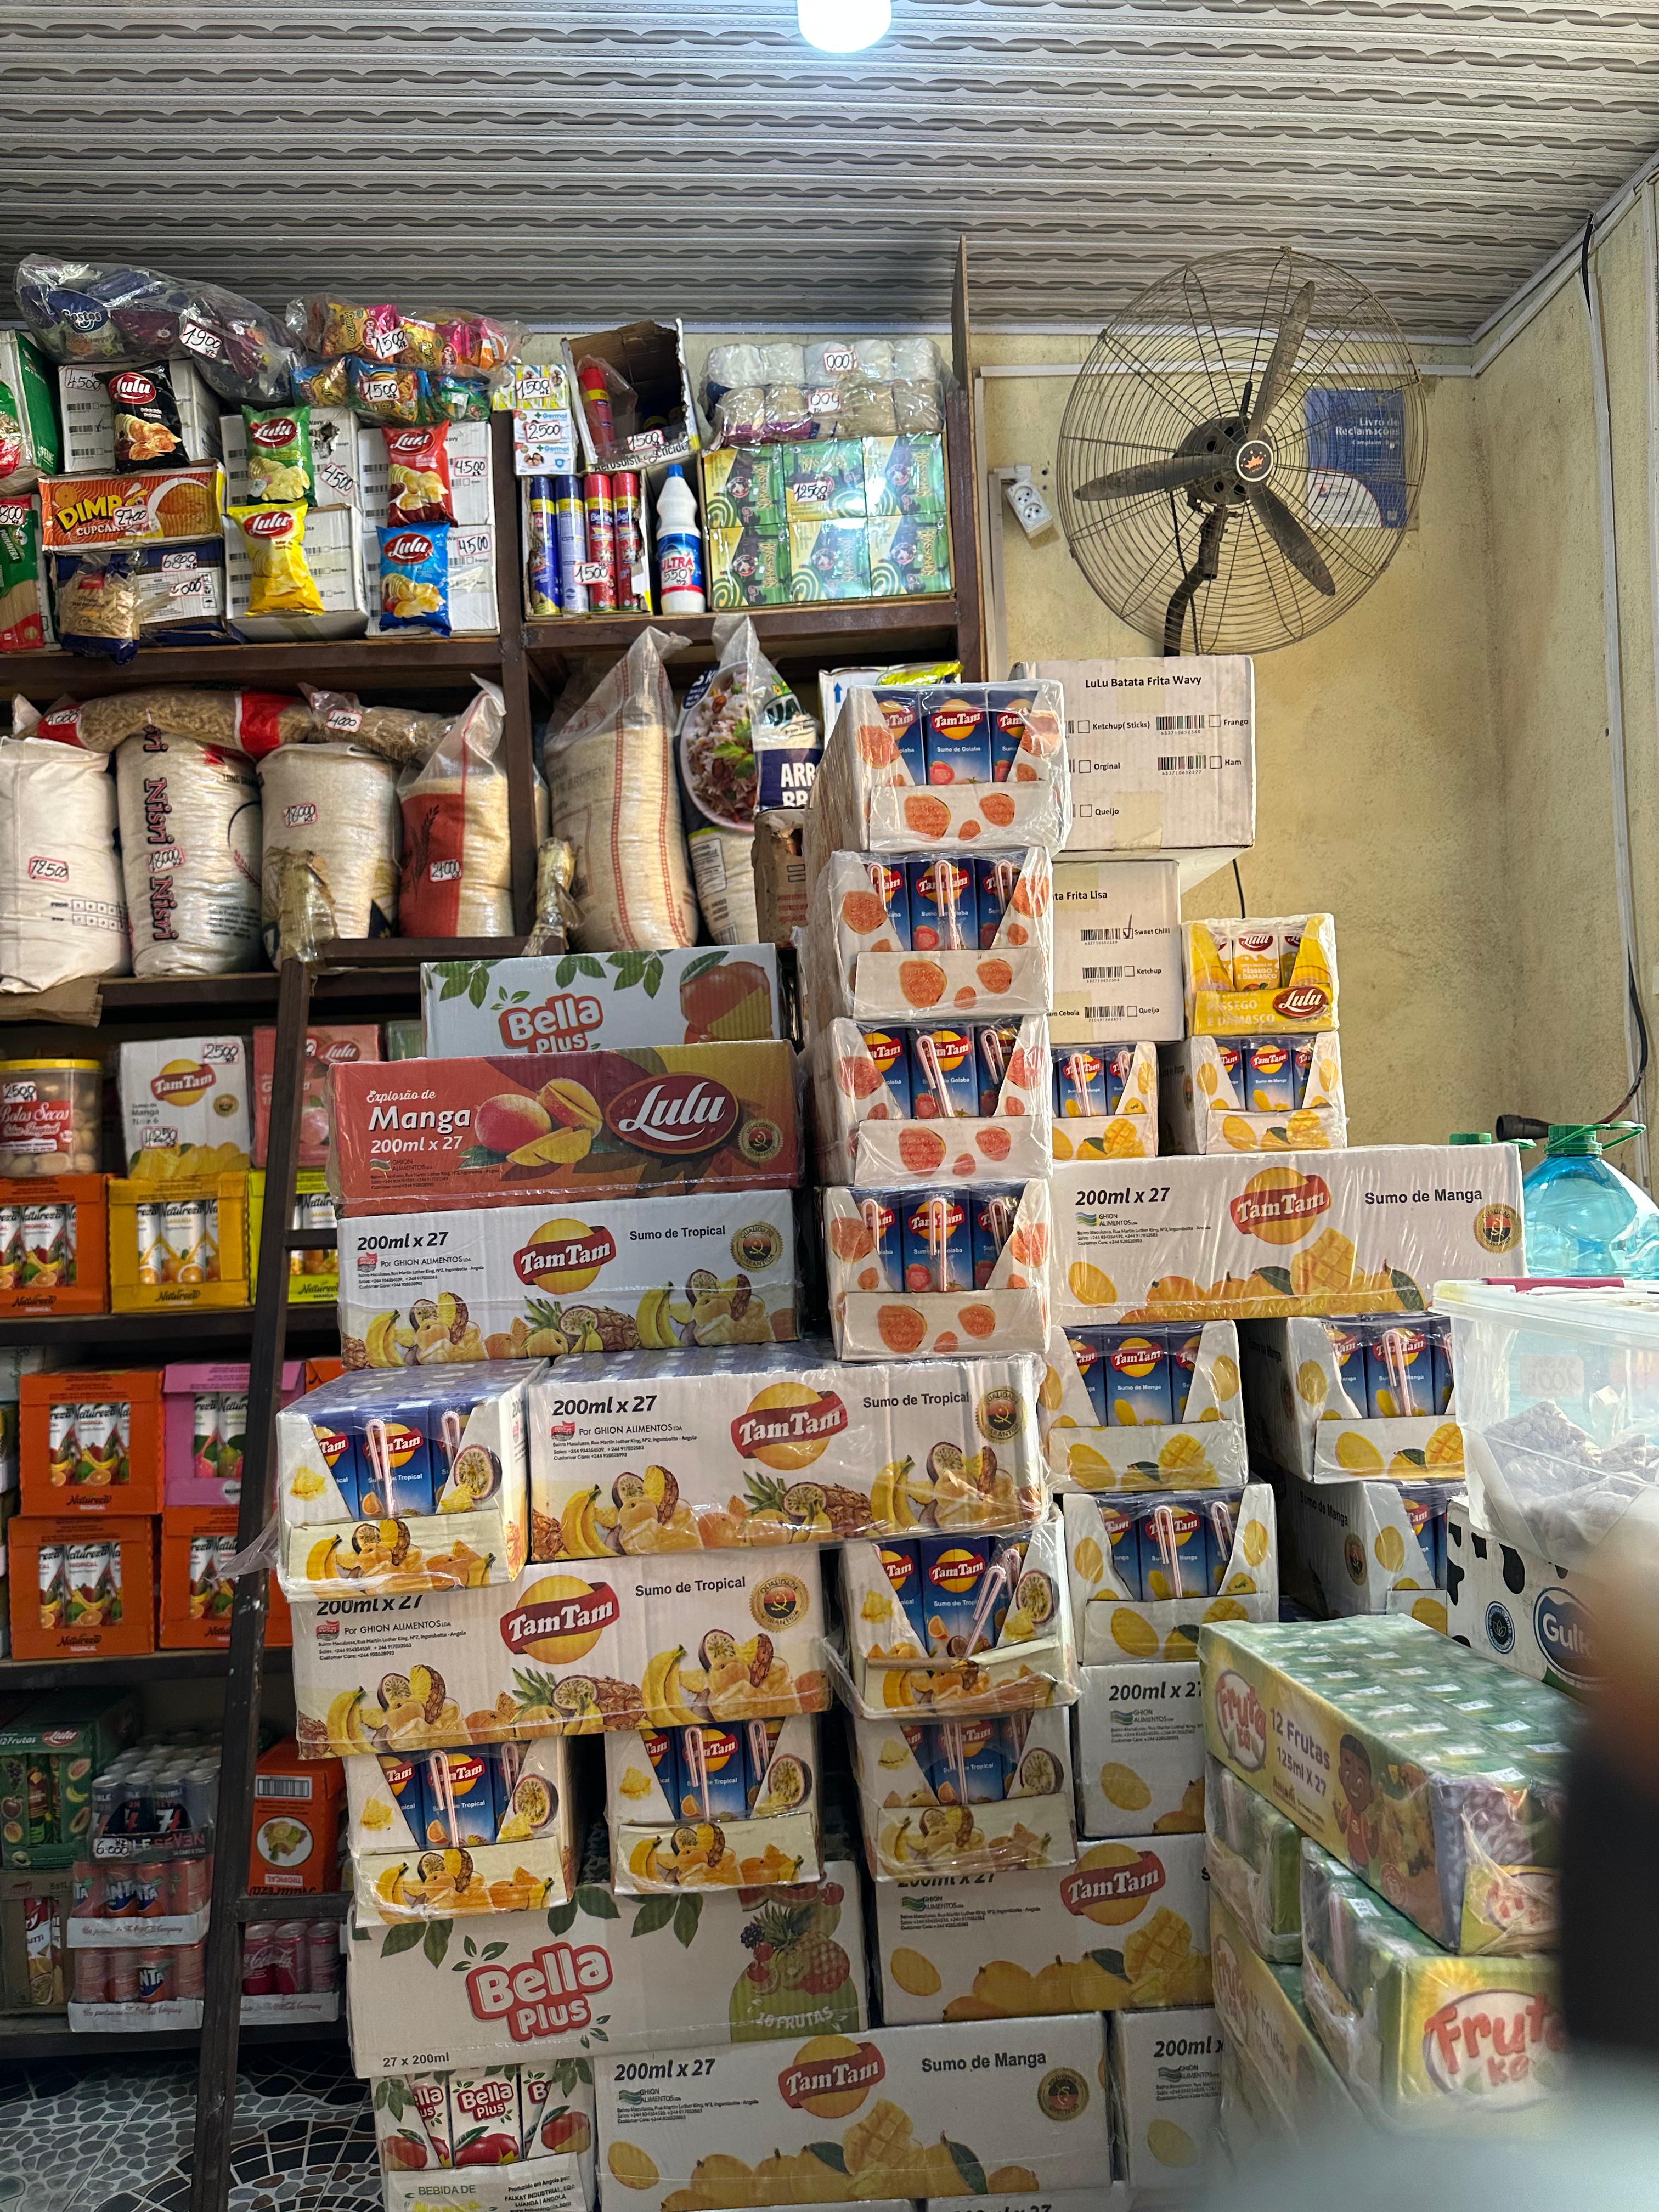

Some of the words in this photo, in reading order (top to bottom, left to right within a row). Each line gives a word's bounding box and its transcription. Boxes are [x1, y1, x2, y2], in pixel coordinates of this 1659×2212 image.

[255, 419, 294, 442] Lulu
[1359, 417, 1384, 427] Livro
[544, 445, 569, 453] Germol
[249, 511, 294, 535] Lulu
[388, 536, 430, 560] Lulu
[663, 568, 688, 582] 550
[1085, 677, 1109, 689] LuLu
[1111, 676, 1144, 688] Batata
[1147, 676, 1171, 686] Frita
[1172, 675, 1202, 686] Wavy
[934, 711, 981, 729] TamTam
[1223, 717, 1249, 727] Frango
[1094, 762, 1121, 771] Orginal
[1224, 758, 1242, 766] Ham
[144, 777, 175, 844] Nisri
[1094, 808, 1120, 816] Queijo
[1066, 890, 1088, 900] Frita
[1090, 890, 1108, 900] Lisa
[150, 876, 180, 940] Nisri
[1137, 967, 1162, 976] Ketchup
[1139, 1006, 1160, 1015] Queijo
[1278, 989, 1323, 1013] Lulu
[507, 997, 601, 1040] Bella
[1059, 1009, 1080, 1017] Cebola
[535, 1030, 586, 1053] Plus
[1252, 1054, 1288, 1066] TamTam
[155, 1073, 212, 1095] TamTam
[366, 1090, 420, 1104] Explosão
[421, 1089, 436, 1100] de
[368, 1105, 471, 1134] Manga
[619, 1080, 727, 1142] Lulu
[371, 1136, 425, 1154] 200ml
[428, 1140, 439, 1151] x
[442, 1135, 464, 1150] 27
[1075, 1187, 1131, 1206] 200ml
[1134, 1190, 1146, 1203] x
[1148, 1187, 1170, 1203] 27
[1364, 1192, 1407, 1205] Sumo
[1412, 1190, 1430, 1203] de
[1434, 1188, 1482, 1205] Manga
[1237, 1193, 1325, 1224] TamTam
[357, 1233, 410, 1251] 200ml
[413, 1236, 424, 1248] x
[426, 1231, 449, 1246] 27
[630, 1228, 662, 1242] Sumo
[664, 1227, 679, 1240] de
[681, 1224, 726, 1240] Tropical
[393, 1259, 420, 1267] GHION
[421, 1255, 463, 1265] ALIMENTOS
[521, 1241, 611, 1276] TamTam
[1114, 1348, 1162, 1364] TamTam
[1142, 1383, 1162, 1392] Manga
[552, 1396, 613, 1416] 200ml
[616, 1400, 629, 1413] x
[631, 1395, 658, 1412] 27
[862, 1395, 899, 1409] Sumo
[902, 1394, 917, 1407] de
[921, 1391, 969, 1408] Tropical
[594, 1426, 623, 1435] GHION
[625, 1424, 673, 1434] ALIMENTOS
[738, 1407, 843, 1447] TamTam
[397, 1472, 423, 1482] Tropical
[1299, 1491, 1317, 1509] Sumo
[1317, 1501, 1327, 1514] de
[1327, 1505, 1349, 1526] Manga
[932, 1560, 985, 1579] TamTam
[635, 1581, 672, 1597] Sumo
[675, 1580, 691, 1595] de
[694, 1576, 746, 1594] Tropical
[382, 1598, 395, 1611] x
[360, 1624, 390, 1634] GHION
[392, 1620, 441, 1632] ALIMENTOS
[507, 1600, 614, 1644] TamTam
[1108, 1681, 1166, 1701] 200ml
[1170, 1685, 1181, 1699] x
[1215, 1674, 1266, 1740] Fruta
[1270, 1708, 1284, 1736] 12
[1286, 1719, 1330, 1771] Frutas
[715, 1776, 739, 1786] Tropical
[1277, 1746, 1305, 1781] 125ml
[1314, 1774, 1327, 1797] 27
[462, 1799, 486, 1809] Tropical
[1068, 1867, 1160, 1905] TamTam
[478, 1946, 603, 2015] Bella
[516, 1995, 589, 2036] Plus
[775, 2005, 834, 2030] FRUTAS
[1153, 2035, 1212, 2058] 200ml
[383, 2057, 397, 2067] 27
[411, 2052, 449, 2065] 200ml
[921, 2057, 967, 2073] Sumo
[970, 2055, 991, 2070] de
[994, 2051, 1047, 2072] Manga
[614, 2059, 674, 2081] 200ml
[676, 2063, 689, 2077] x
[691, 2058, 716, 2076] 27
[786, 2059, 879, 2097] TamTam
[460, 2083, 514, 2110] Bella
[476, 2102, 505, 2118] Plus
[418, 2185, 458, 2196] BEBIDA
[461, 2185, 476, 2194] DE
[508, 2181, 533, 2192] Produzido
[541, 2176, 560, 2186] Angola
[543, 2194, 567, 2205] ANGOLA
